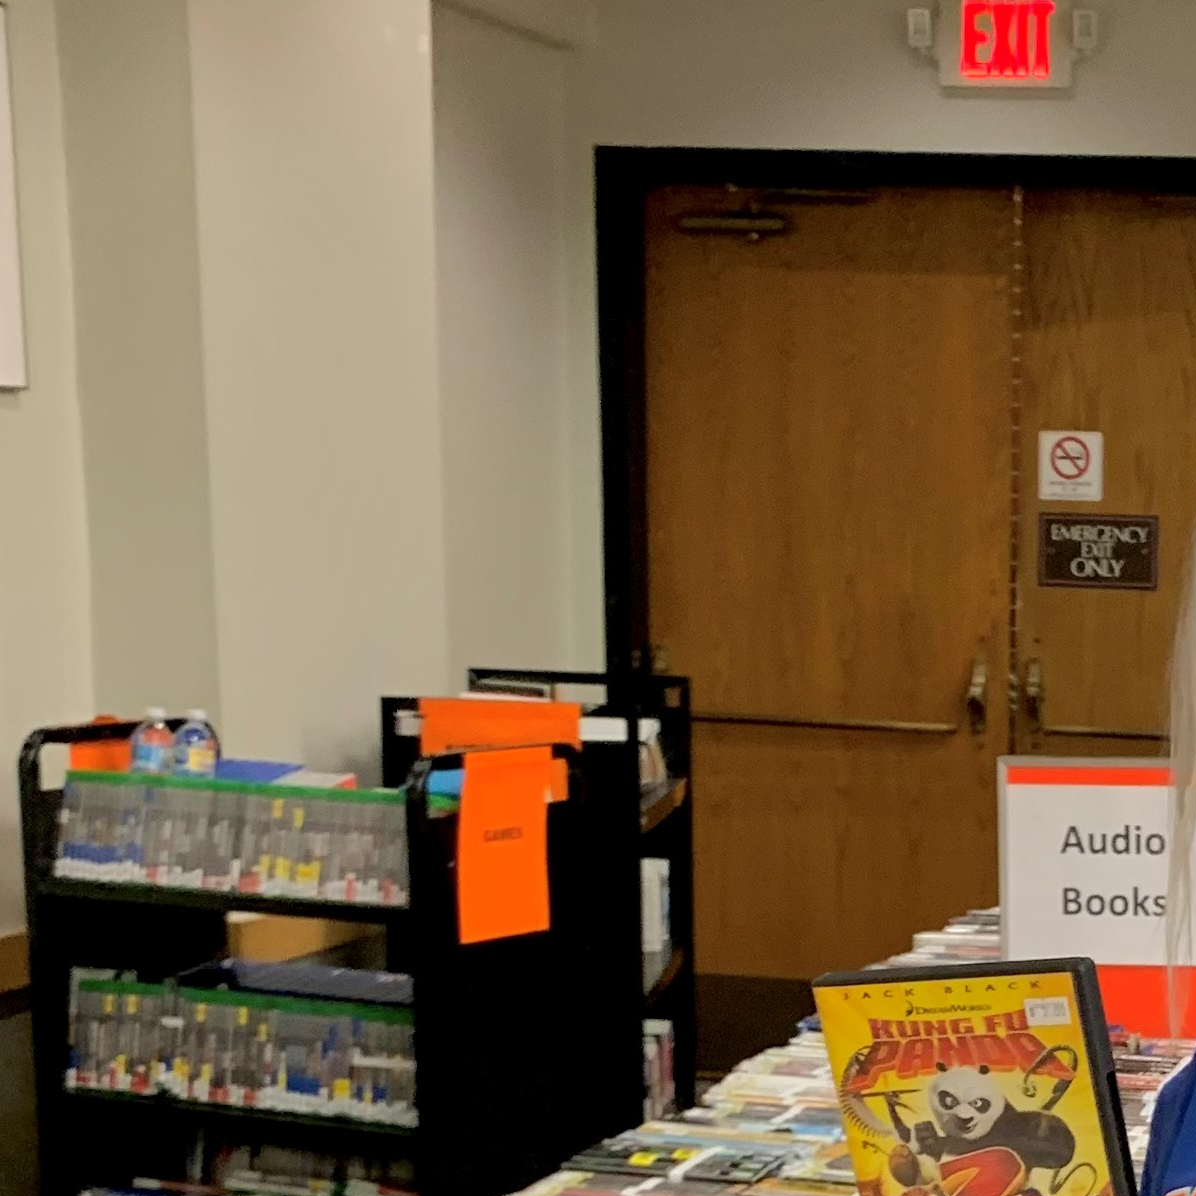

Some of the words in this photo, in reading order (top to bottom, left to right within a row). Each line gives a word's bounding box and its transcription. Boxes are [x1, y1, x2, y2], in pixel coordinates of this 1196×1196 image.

[961, 1, 1055, 80] EXIT
[1051, 524, 1149, 543] EMERGENCY
[1080, 541, 1116, 558] EXIT
[1070, 557, 1125, 577] ONLY
[1061, 825, 1166, 855] Audio
[1062, 887, 1167, 916] Books
[843, 988, 915, 1000] JACK
[944, 980, 1041, 994] BLACK
[868, 1018, 975, 1039] KUNG
[982, 1009, 1030, 1034] FU
[845, 1032, 1077, 1090] PANDA
